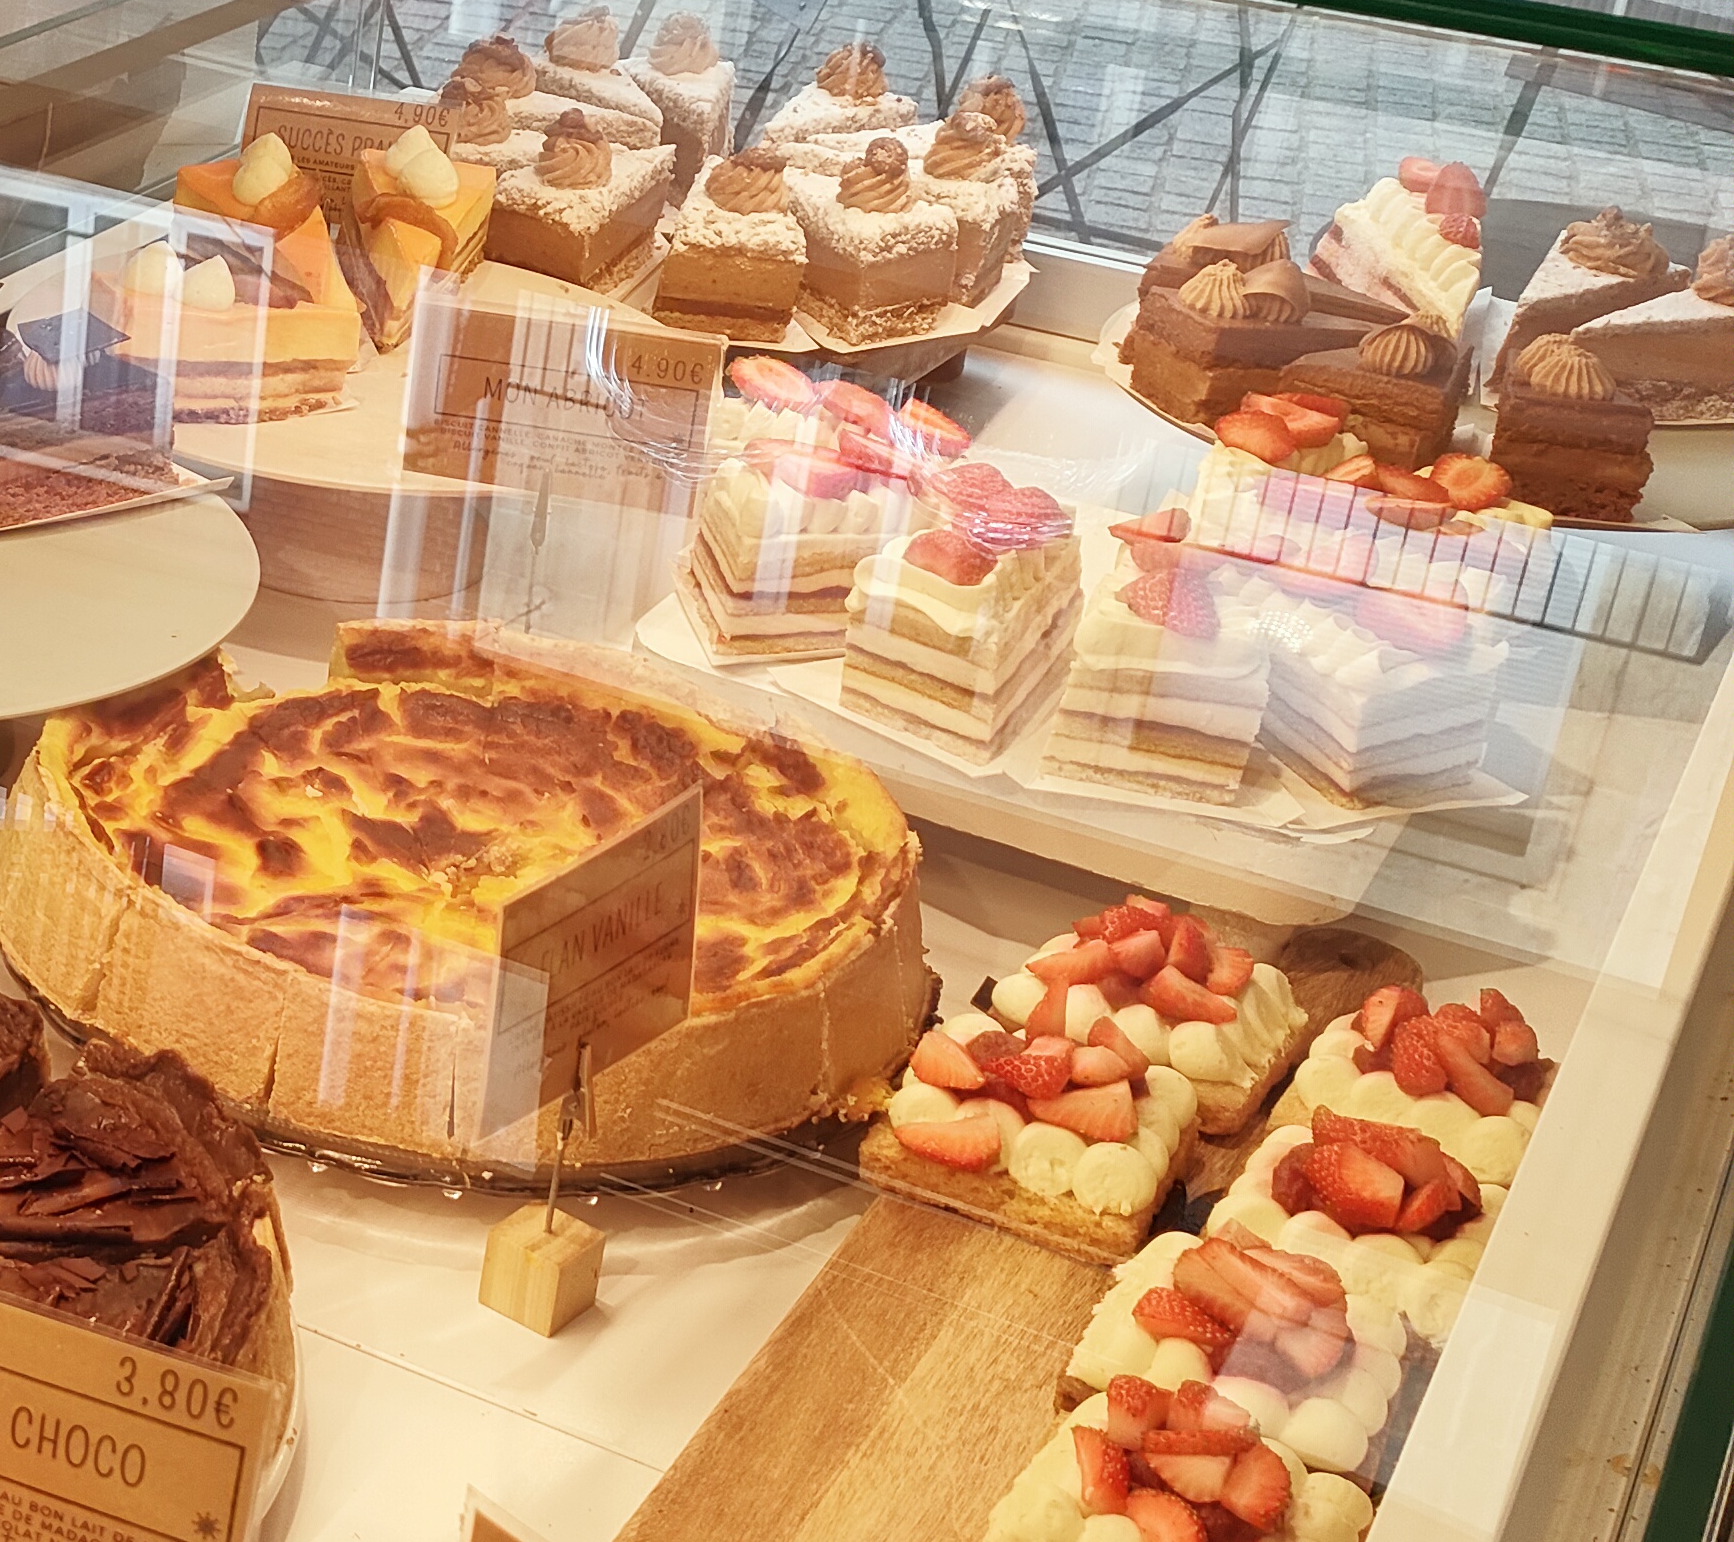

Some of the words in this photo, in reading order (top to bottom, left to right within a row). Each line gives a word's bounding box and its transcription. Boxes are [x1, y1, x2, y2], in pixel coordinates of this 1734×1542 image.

[277, 125, 344, 156] SUCCÈS
[313, 159, 356, 170] AMATEURS
[483, 376, 537, 405] MON
[10, 1406, 147, 1487] CHOCO
[0, 1490, 22, 1506] AU
[29, 1500, 64, 1522] BON
[71, 1516, 105, 1537] LAIT
[12, 1509, 33, 1526] DE
